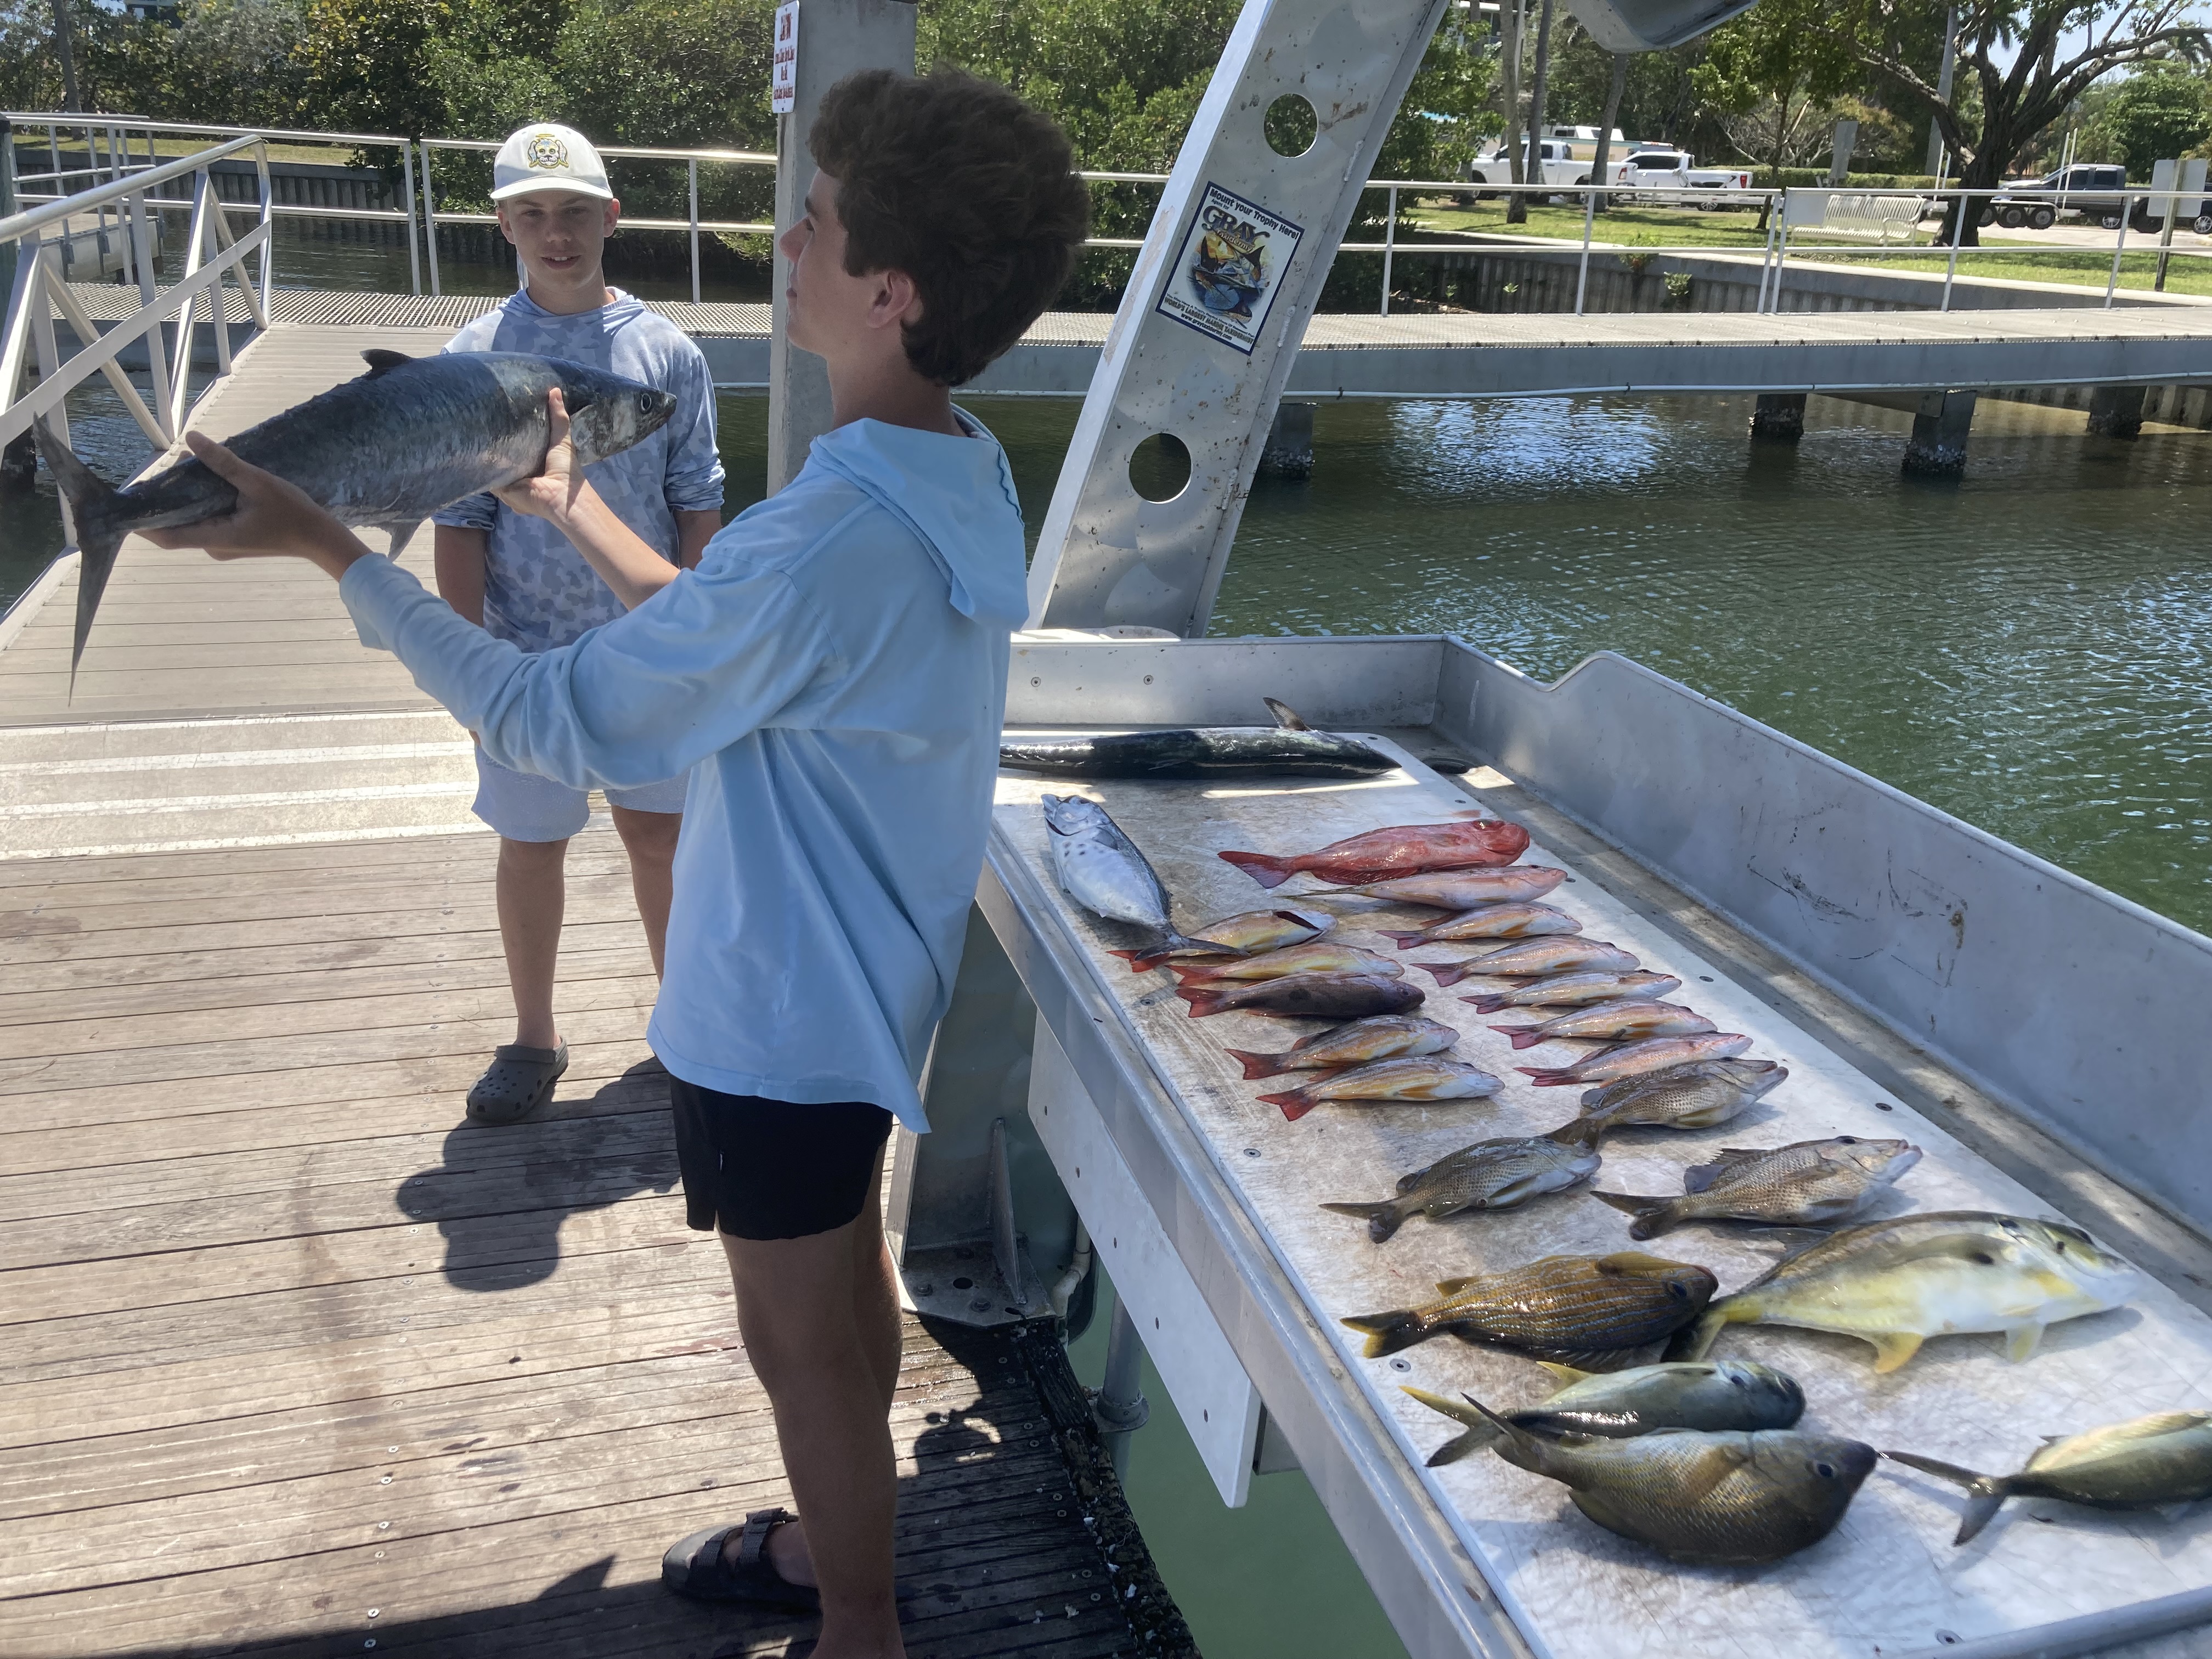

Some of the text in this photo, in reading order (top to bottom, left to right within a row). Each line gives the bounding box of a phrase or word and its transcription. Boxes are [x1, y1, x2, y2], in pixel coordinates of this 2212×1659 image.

[1201, 205, 1271, 245] GRAY
[1209, 188, 1299, 240] Mount your Trophy Here!
[1216, 229, 1253, 252] Taxidermy
[1165, 297, 1186, 311] WORLD'S
[1184, 307, 1206, 321] LARGEST
[1223, 326, 1254, 344] TAXIDERMIST
